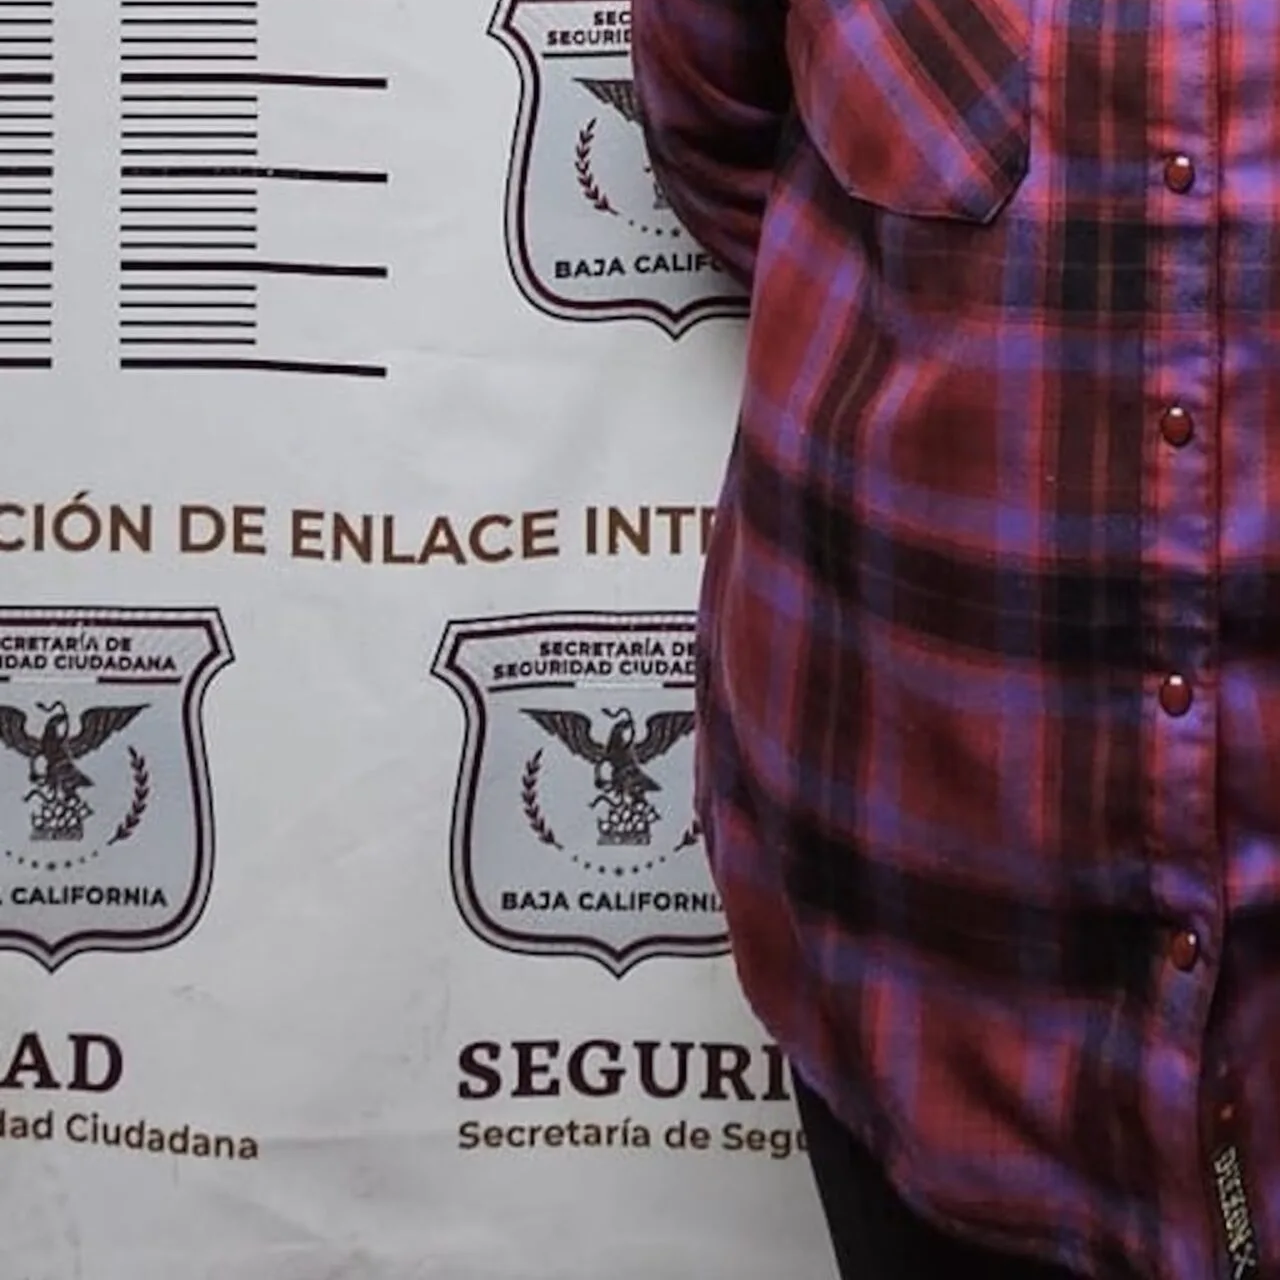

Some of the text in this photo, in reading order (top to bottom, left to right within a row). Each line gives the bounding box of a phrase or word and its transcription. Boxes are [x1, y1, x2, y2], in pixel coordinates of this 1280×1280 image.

[554, 256, 626, 279] BAJA
[179, 504, 267, 556] DE
[291, 508, 560, 566] ENLACE
[105, 636, 133, 653] DE
[539, 637, 666, 658] SECRETARÍA
[53, 654, 177, 672] CIUDADANA
[493, 659, 613, 683] SEGURIDAD
[10, 885, 168, 908] CALIFORNIA
[501, 890, 570, 911] BAJA
[456, 1038, 790, 1102] SEGURI
[0, 1108, 259, 1161] ad Ciudadana
[458, 1117, 651, 1151] Secretaría
[664, 1119, 712, 1151] de
